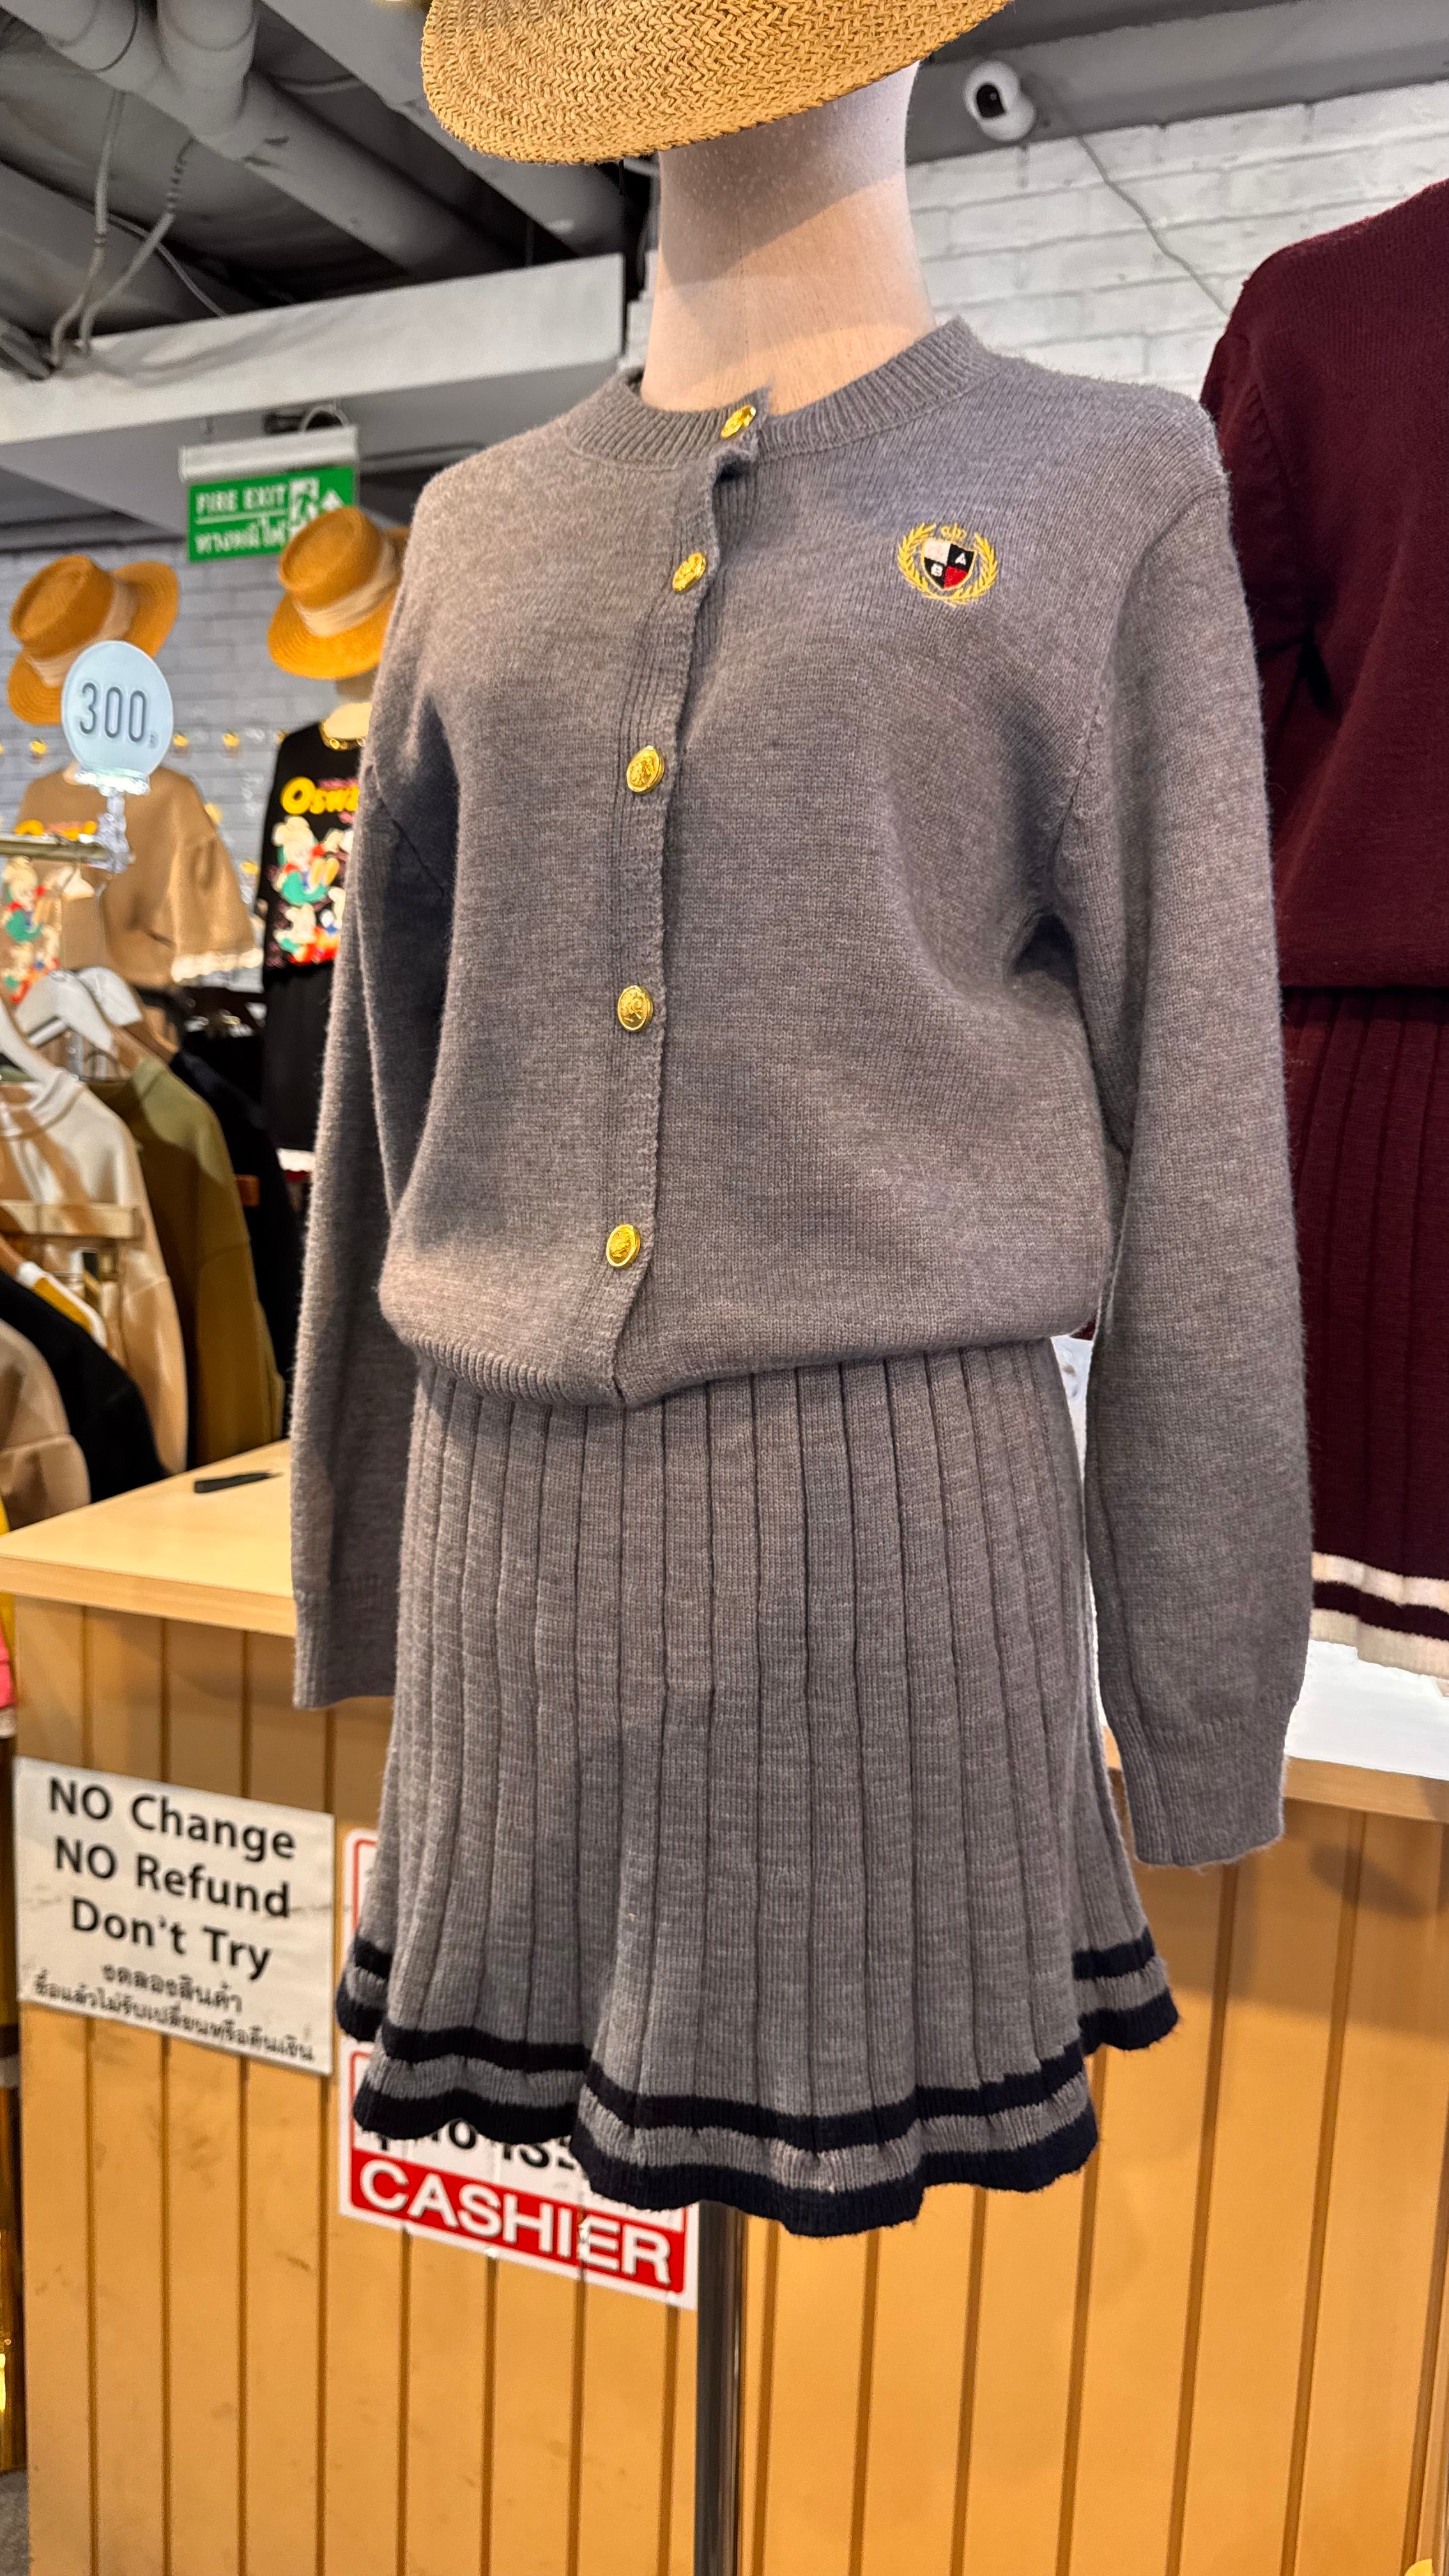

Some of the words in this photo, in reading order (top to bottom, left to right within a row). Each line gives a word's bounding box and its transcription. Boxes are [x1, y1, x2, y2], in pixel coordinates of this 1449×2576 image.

[195, 489, 238, 516] FIRE
[242, 483, 286, 510] EXIT
[49, 1777, 112, 1820] NO
[131, 1794, 296, 1862] Change
[56, 1836, 118, 1880] NO
[135, 1852, 290, 1918] Refund
[72, 1896, 187, 1955] Don't
[203, 1924, 271, 1981] Try
[359, 2158, 672, 2285] CASHIER
